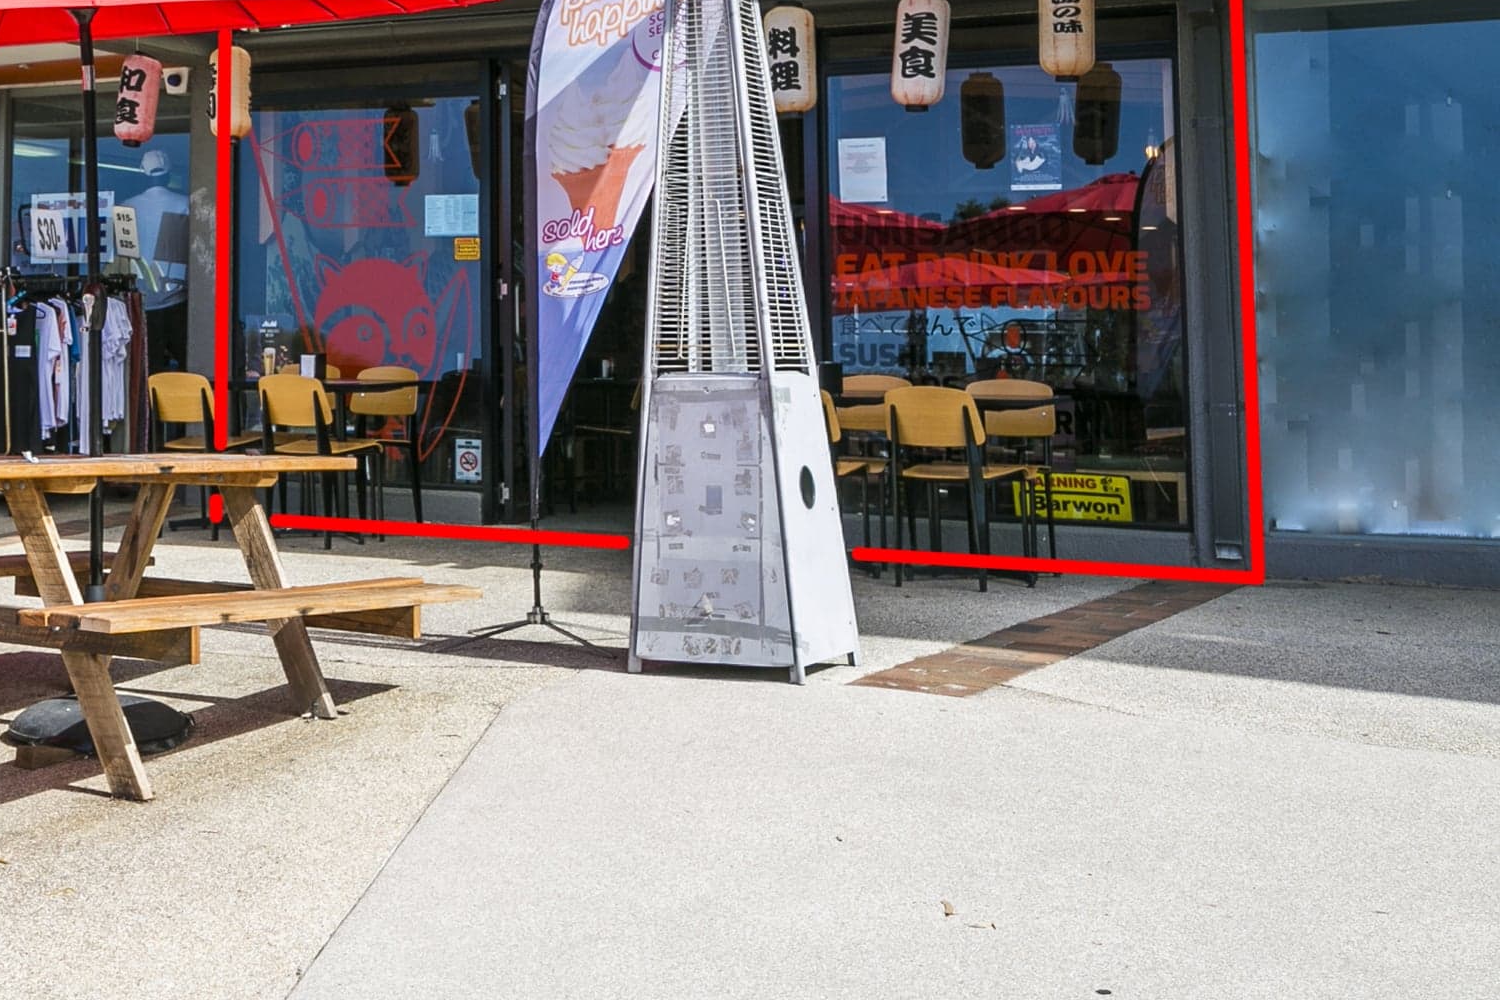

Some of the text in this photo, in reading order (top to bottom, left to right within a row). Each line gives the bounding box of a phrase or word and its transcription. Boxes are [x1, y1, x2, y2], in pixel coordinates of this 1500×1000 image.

[768, 27, 801, 92] 料理
[899, 11, 938, 79] 美食
[122, 227, 130, 235] to
[543, 206, 596, 244] sold
[583, 223, 624, 253] here
[835, 250, 1150, 284] EAT DRINK LOVE
[836, 285, 1151, 310] JAPANESE FLAVOURS
